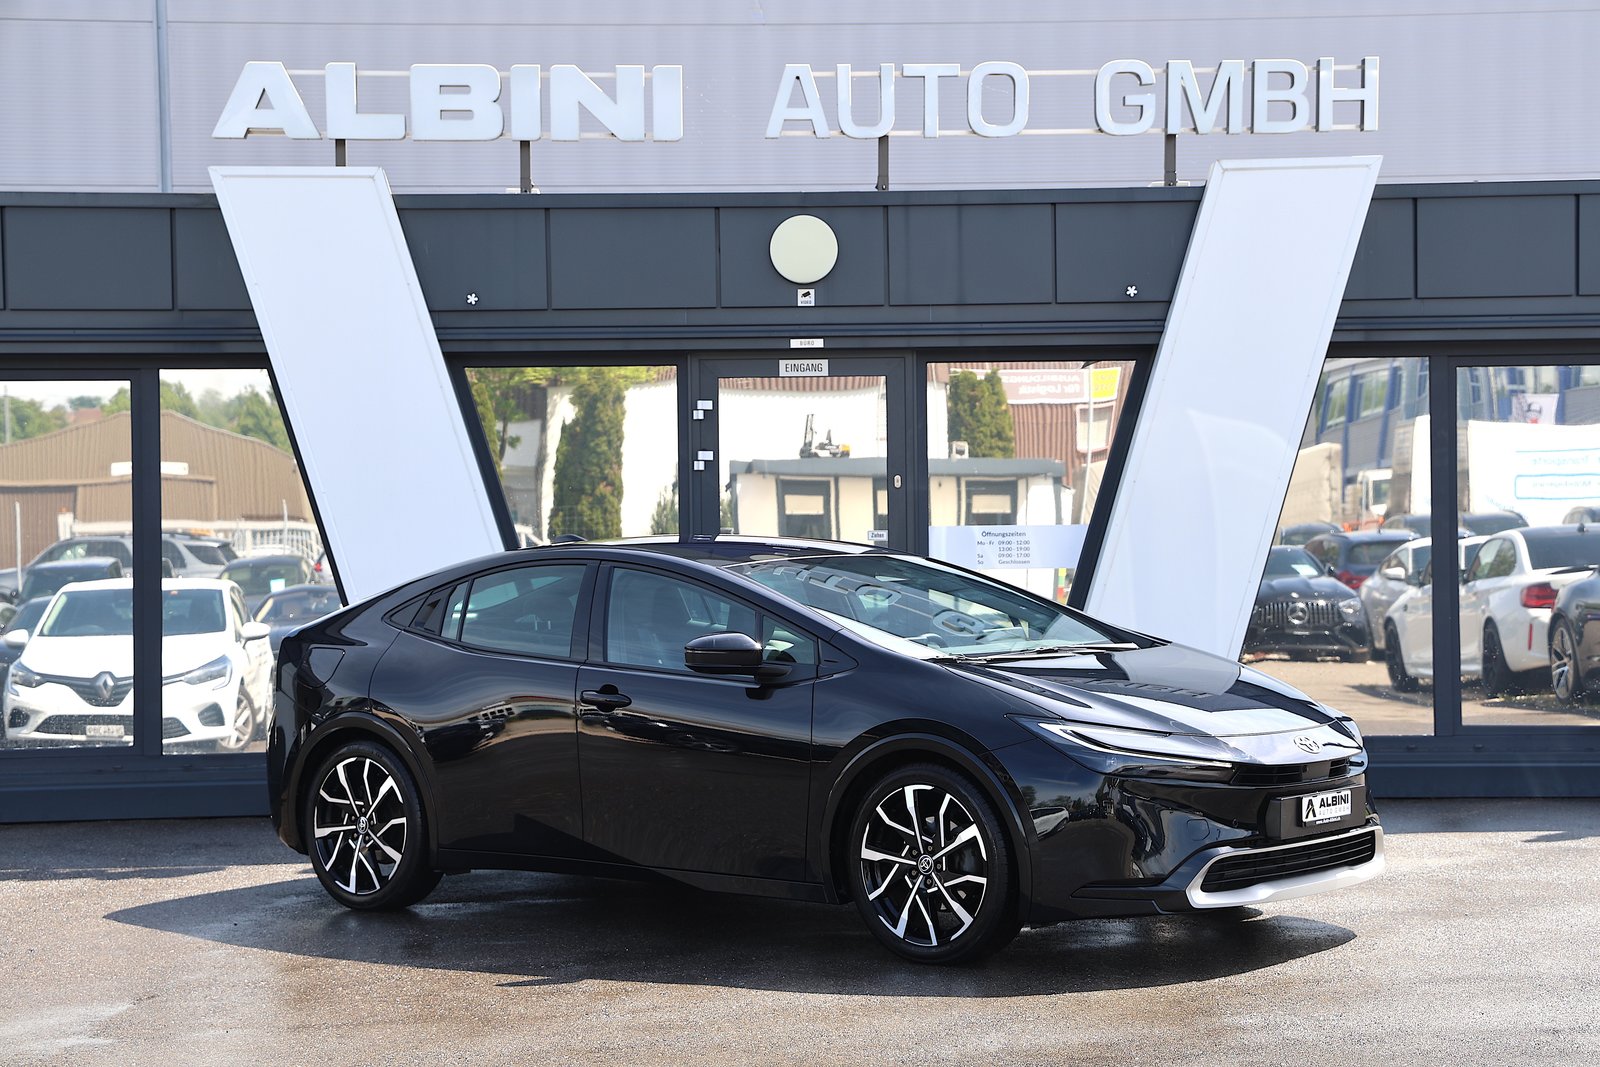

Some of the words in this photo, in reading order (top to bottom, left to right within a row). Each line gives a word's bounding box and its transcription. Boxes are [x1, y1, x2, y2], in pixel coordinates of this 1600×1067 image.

[212, 61, 684, 142] ALBINI
[765, 60, 1030, 139] AUTO
[1095, 56, 1381, 137] GMBH
[785, 362, 823, 373] EINGANG
[981, 530, 1027, 538] Öffnungszeiten
[1319, 793, 1349, 808] ALBINI
